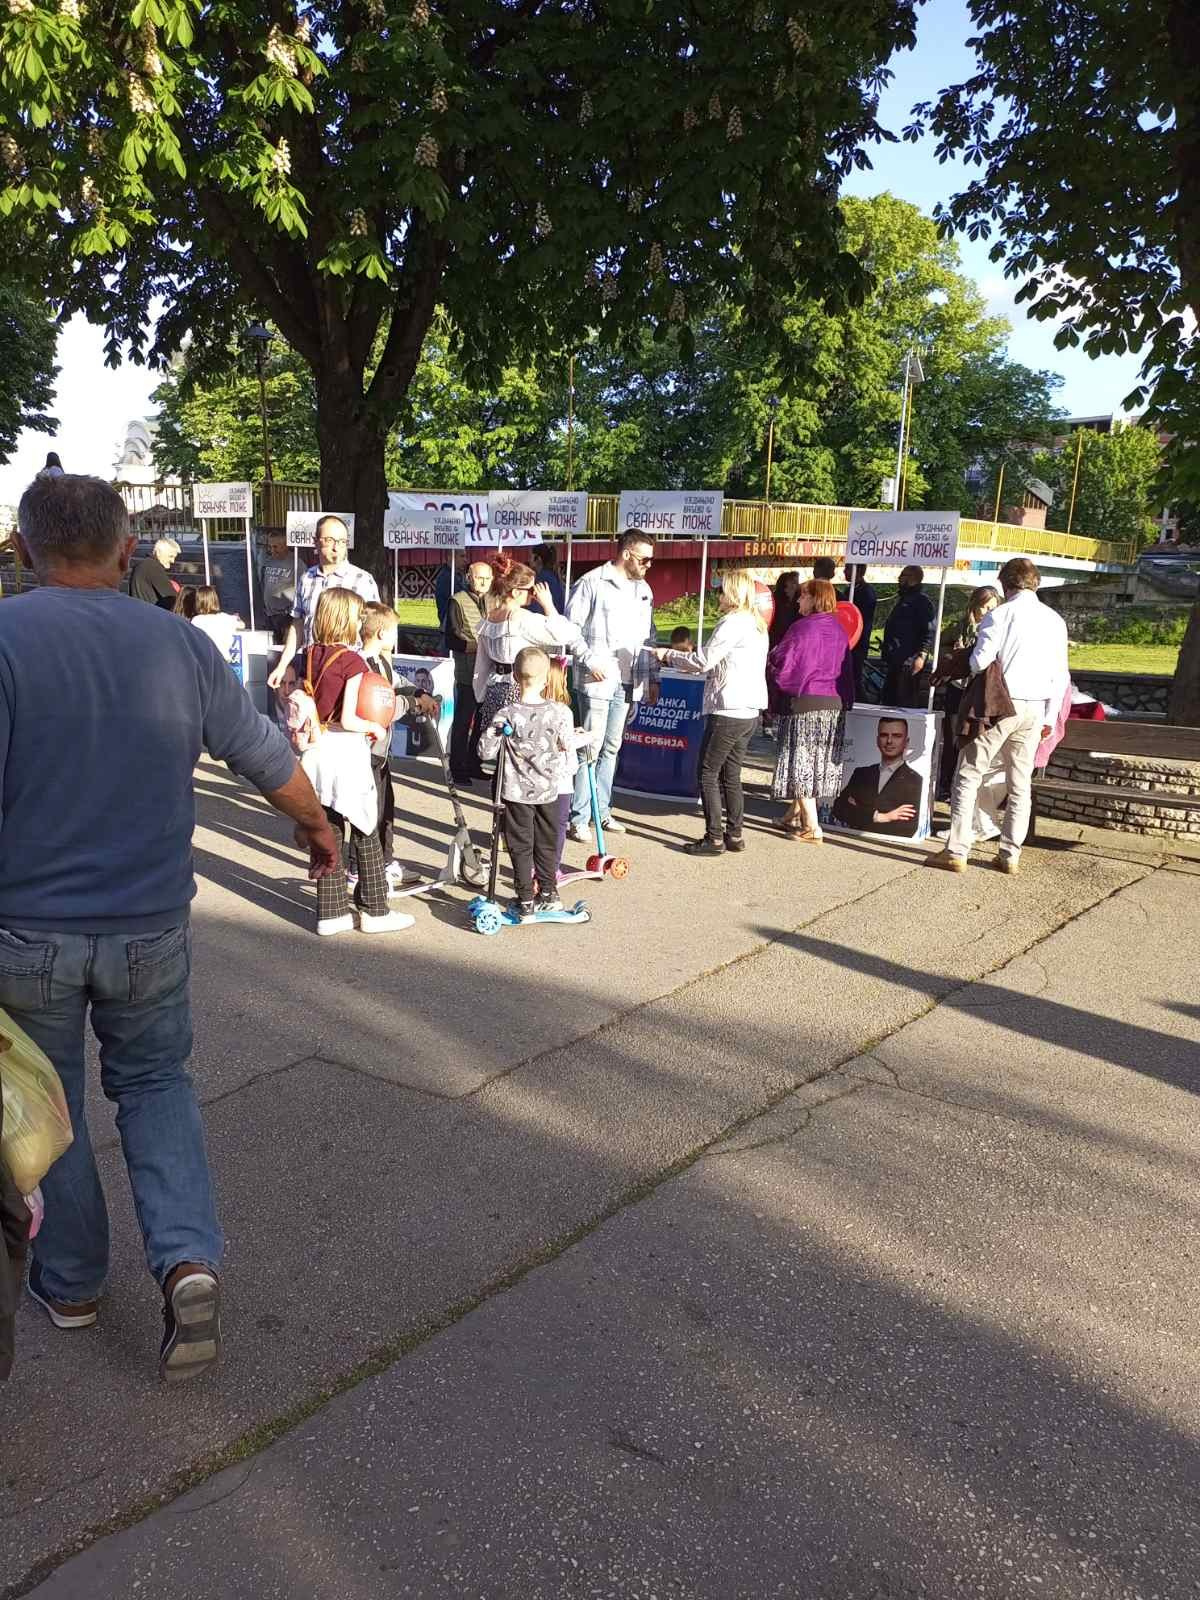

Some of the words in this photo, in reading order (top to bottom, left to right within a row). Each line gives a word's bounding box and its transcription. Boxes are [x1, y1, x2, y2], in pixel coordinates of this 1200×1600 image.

[494, 510, 541, 527] СВАНУЋЕ
[547, 513, 578, 528] МОЖЕ
[626, 511, 676, 529] СВАНУЋЕ
[682, 514, 713, 530] МОЖЕ
[388, 530, 430, 545] СВАНУЋЕ
[433, 532, 460, 546] МОЖЕ
[744, 542, 804, 557] ЕВРОПСКА
[850, 539, 909, 558] СВАНУЋЕ
[912, 542, 951, 559] МОЖЕ
[639, 706, 690, 720] СЛОБОДЕ
[692, 711, 700, 721] И
[638, 716, 679, 730] ПРАВДЕ
[644, 736, 685, 748] СРБИЈА
